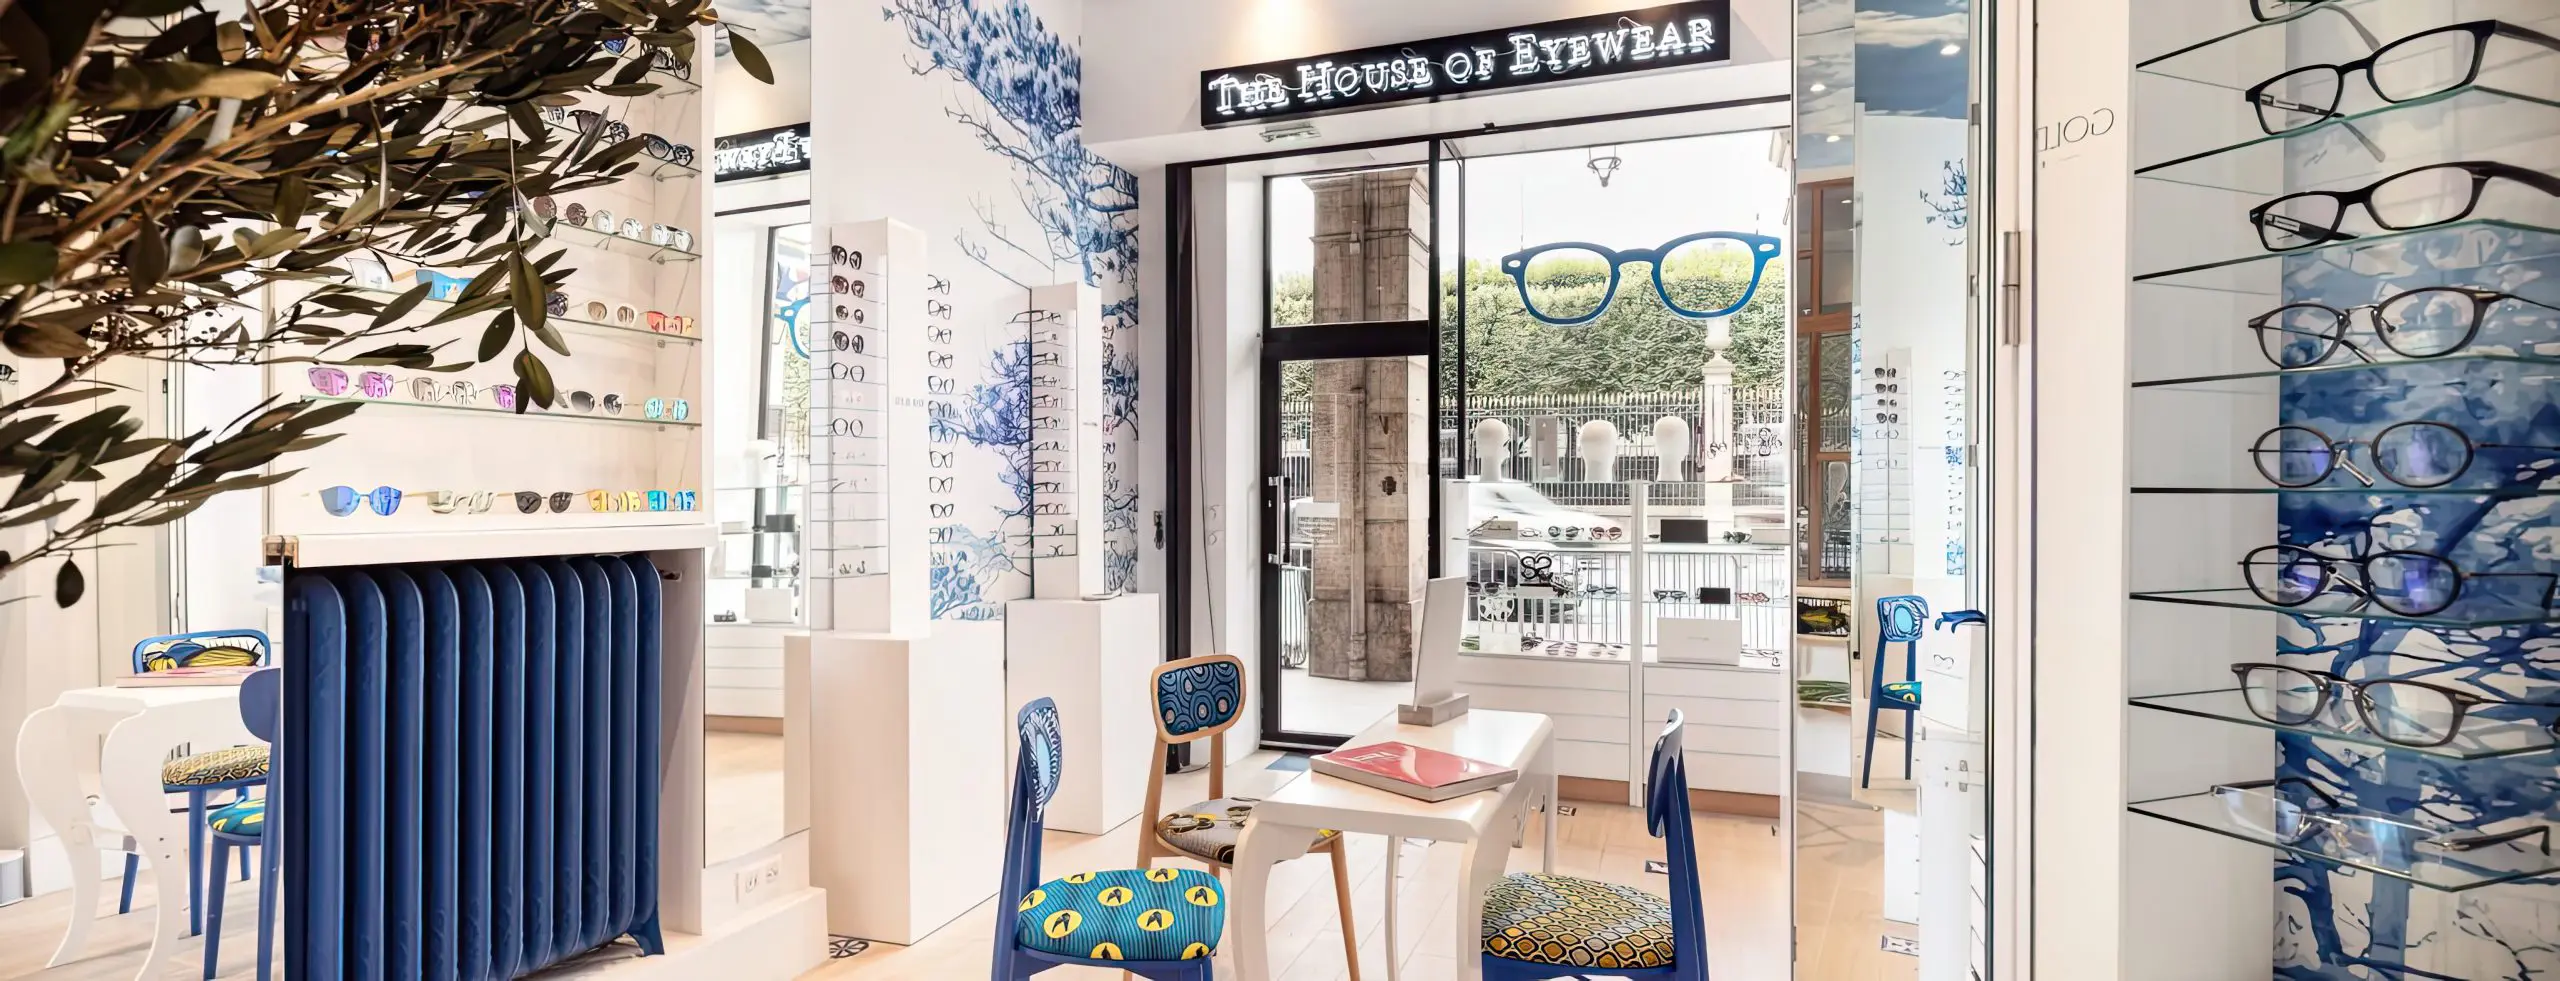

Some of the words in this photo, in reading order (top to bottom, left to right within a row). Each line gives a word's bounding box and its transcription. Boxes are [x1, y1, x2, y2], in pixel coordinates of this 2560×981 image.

[1208, 74, 1289, 113] THE
[1297, 57, 1432, 98] HOUSE
[1445, 48, 1497, 82] OF
[1508, 18, 1715, 75] EYEWEAR
